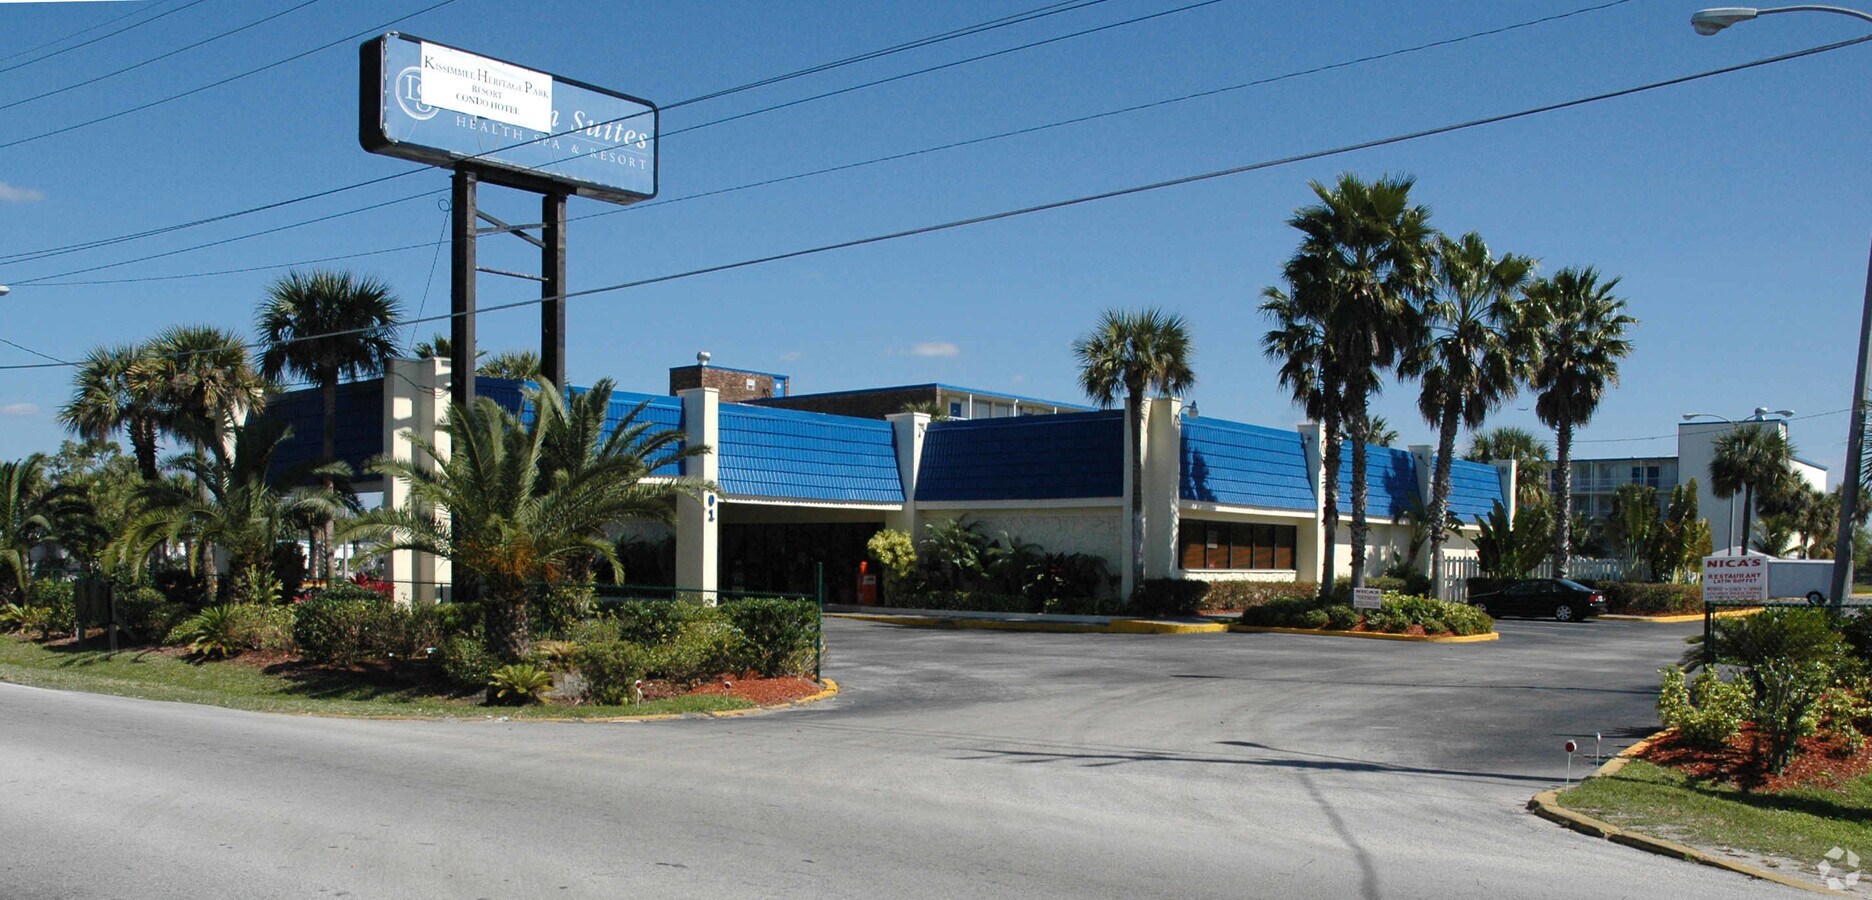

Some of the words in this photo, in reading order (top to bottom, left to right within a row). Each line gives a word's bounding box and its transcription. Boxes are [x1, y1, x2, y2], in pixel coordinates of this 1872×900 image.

[424, 55, 476, 80] KISSIMMEE
[477, 68, 522, 92] HERITAGE
[525, 80, 549, 99] PARK
[471, 84, 503, 99] RESORT
[455, 92, 489, 107] CONDO
[490, 101, 520, 115] HOTEL
[570, 110, 648, 150] Suites
[456, 115, 523, 141] HEALTH
[533, 133, 560, 150] SPA
[571, 144, 579, 154] &
[590, 147, 647, 170] RESORT
[1707, 558, 1761, 568] NICA'S
[1708, 572, 1761, 580] RESTAURANT
